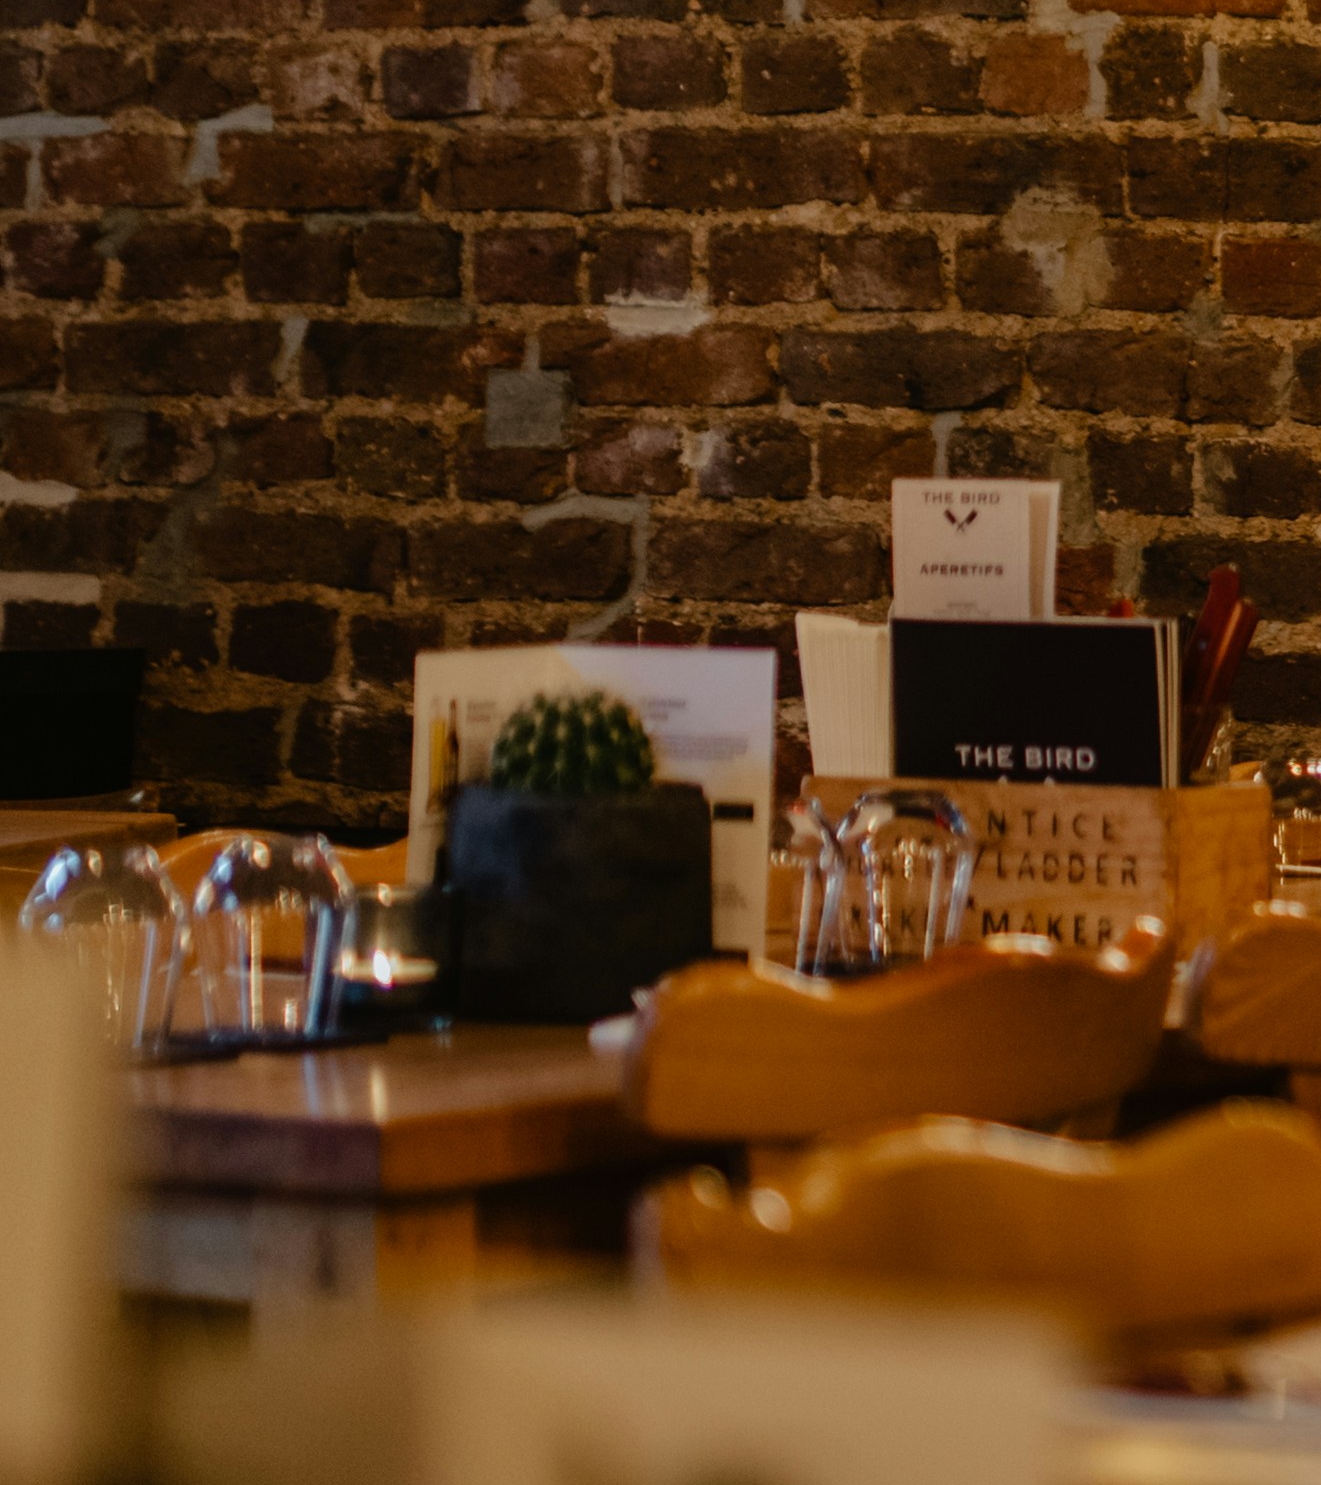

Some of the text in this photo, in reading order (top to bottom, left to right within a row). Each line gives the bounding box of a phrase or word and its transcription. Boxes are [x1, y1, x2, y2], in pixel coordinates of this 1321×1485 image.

[923, 492, 1000, 505] THE BIRD
[955, 744, 1096, 771] THE BIRD
